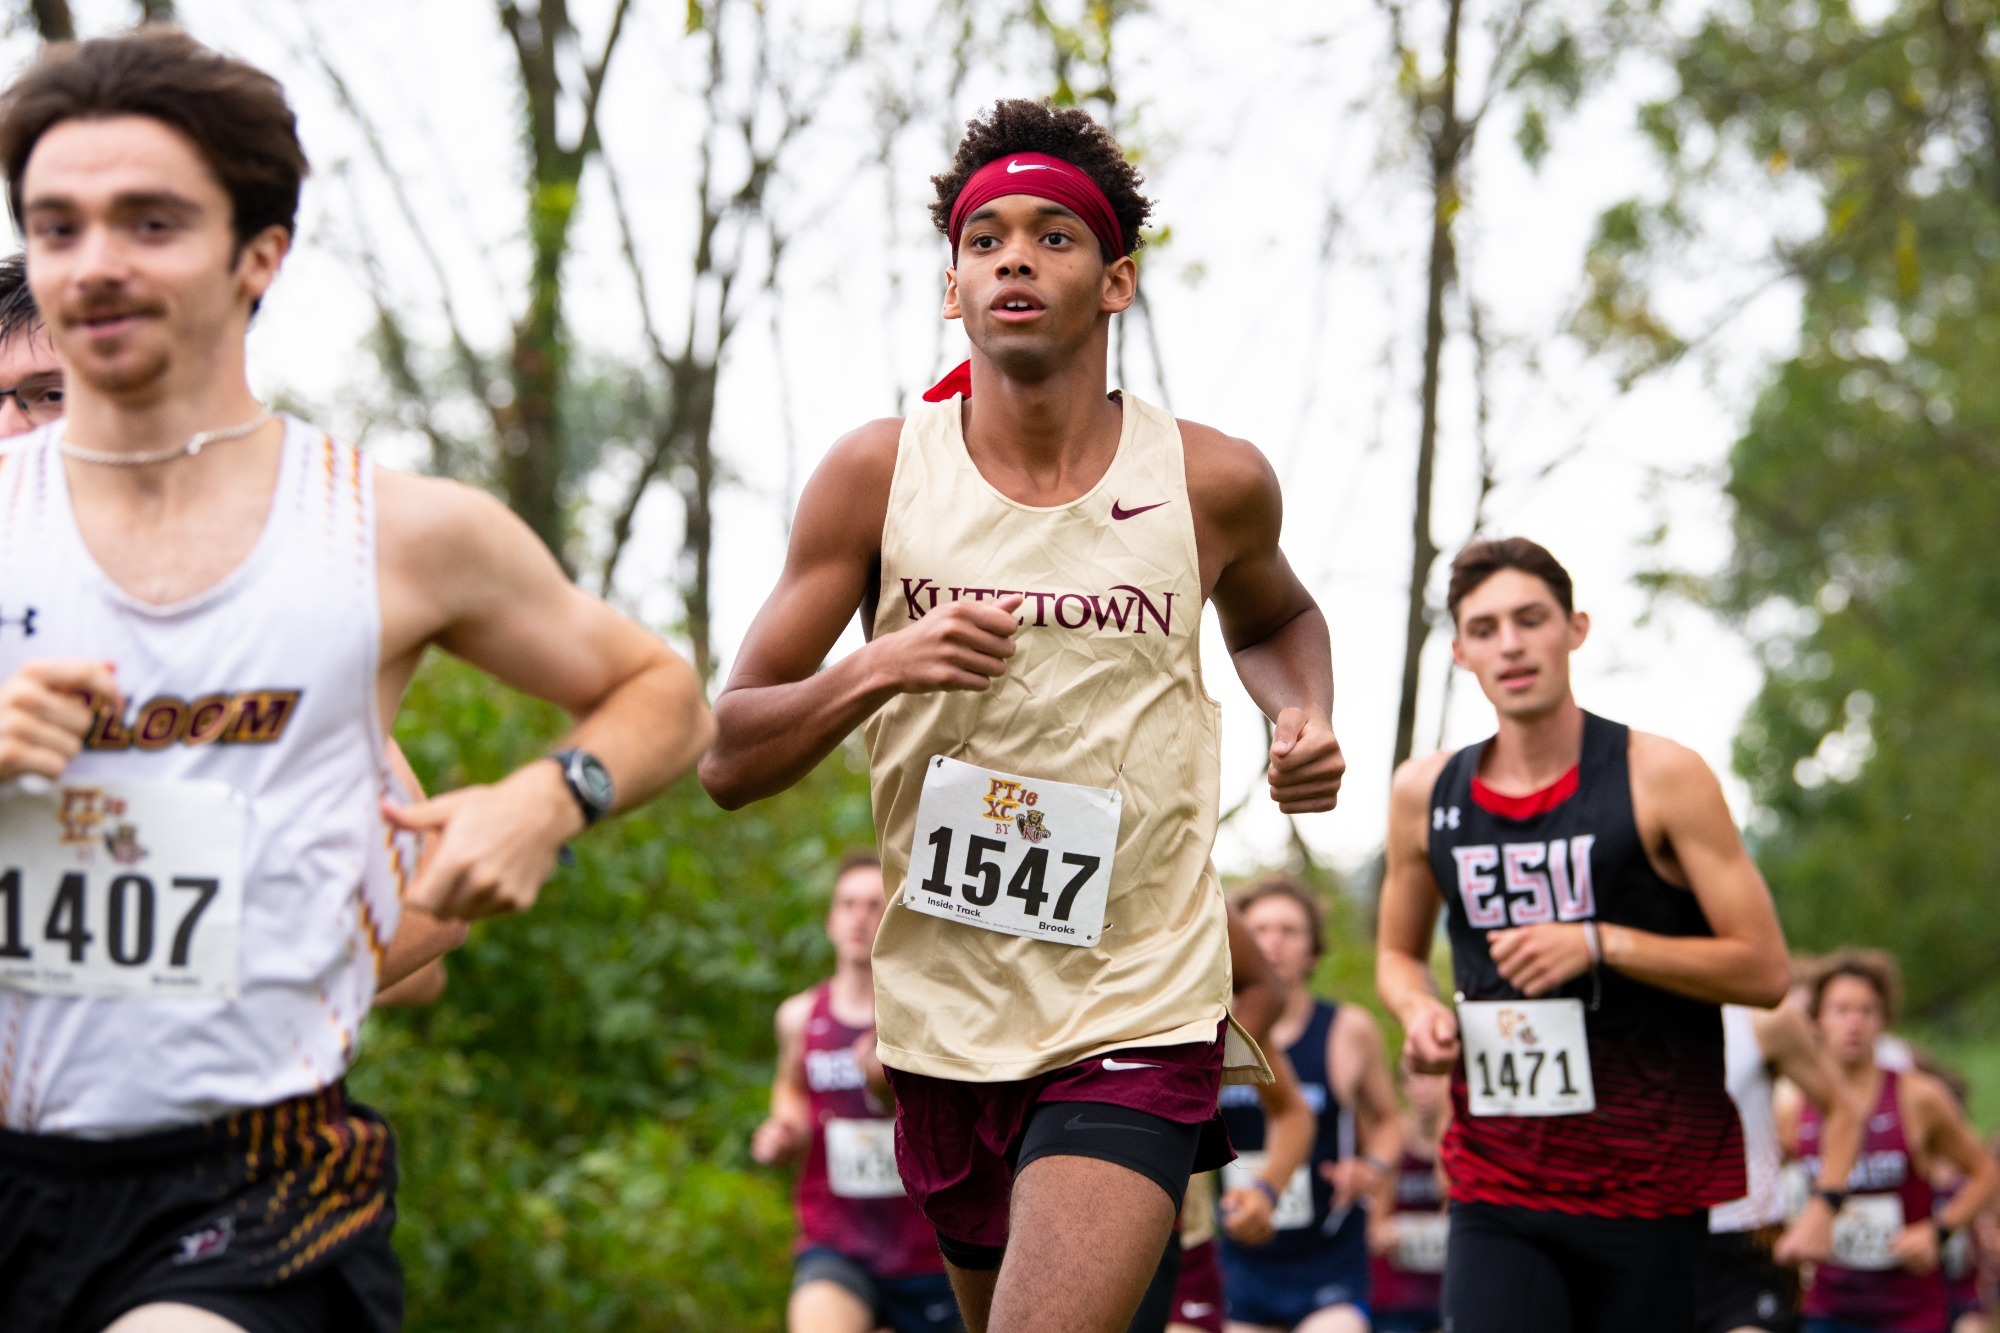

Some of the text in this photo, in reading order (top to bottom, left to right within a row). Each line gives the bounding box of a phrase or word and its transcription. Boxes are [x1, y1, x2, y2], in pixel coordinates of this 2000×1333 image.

[78, 688, 303, 751] LOOM
[986, 800, 1014, 819] XC
[988, 778, 1039, 807] PT 16
[995, 823, 1011, 835] BY
[921, 826, 1101, 921] 1547
[1451, 834, 1596, 928] ESU
[0, 866, 220, 968] 1407
[927, 896, 981, 918] Inside Track
[1038, 921, 1075, 935] Brooks
[1476, 1050, 1579, 1097] 1471
